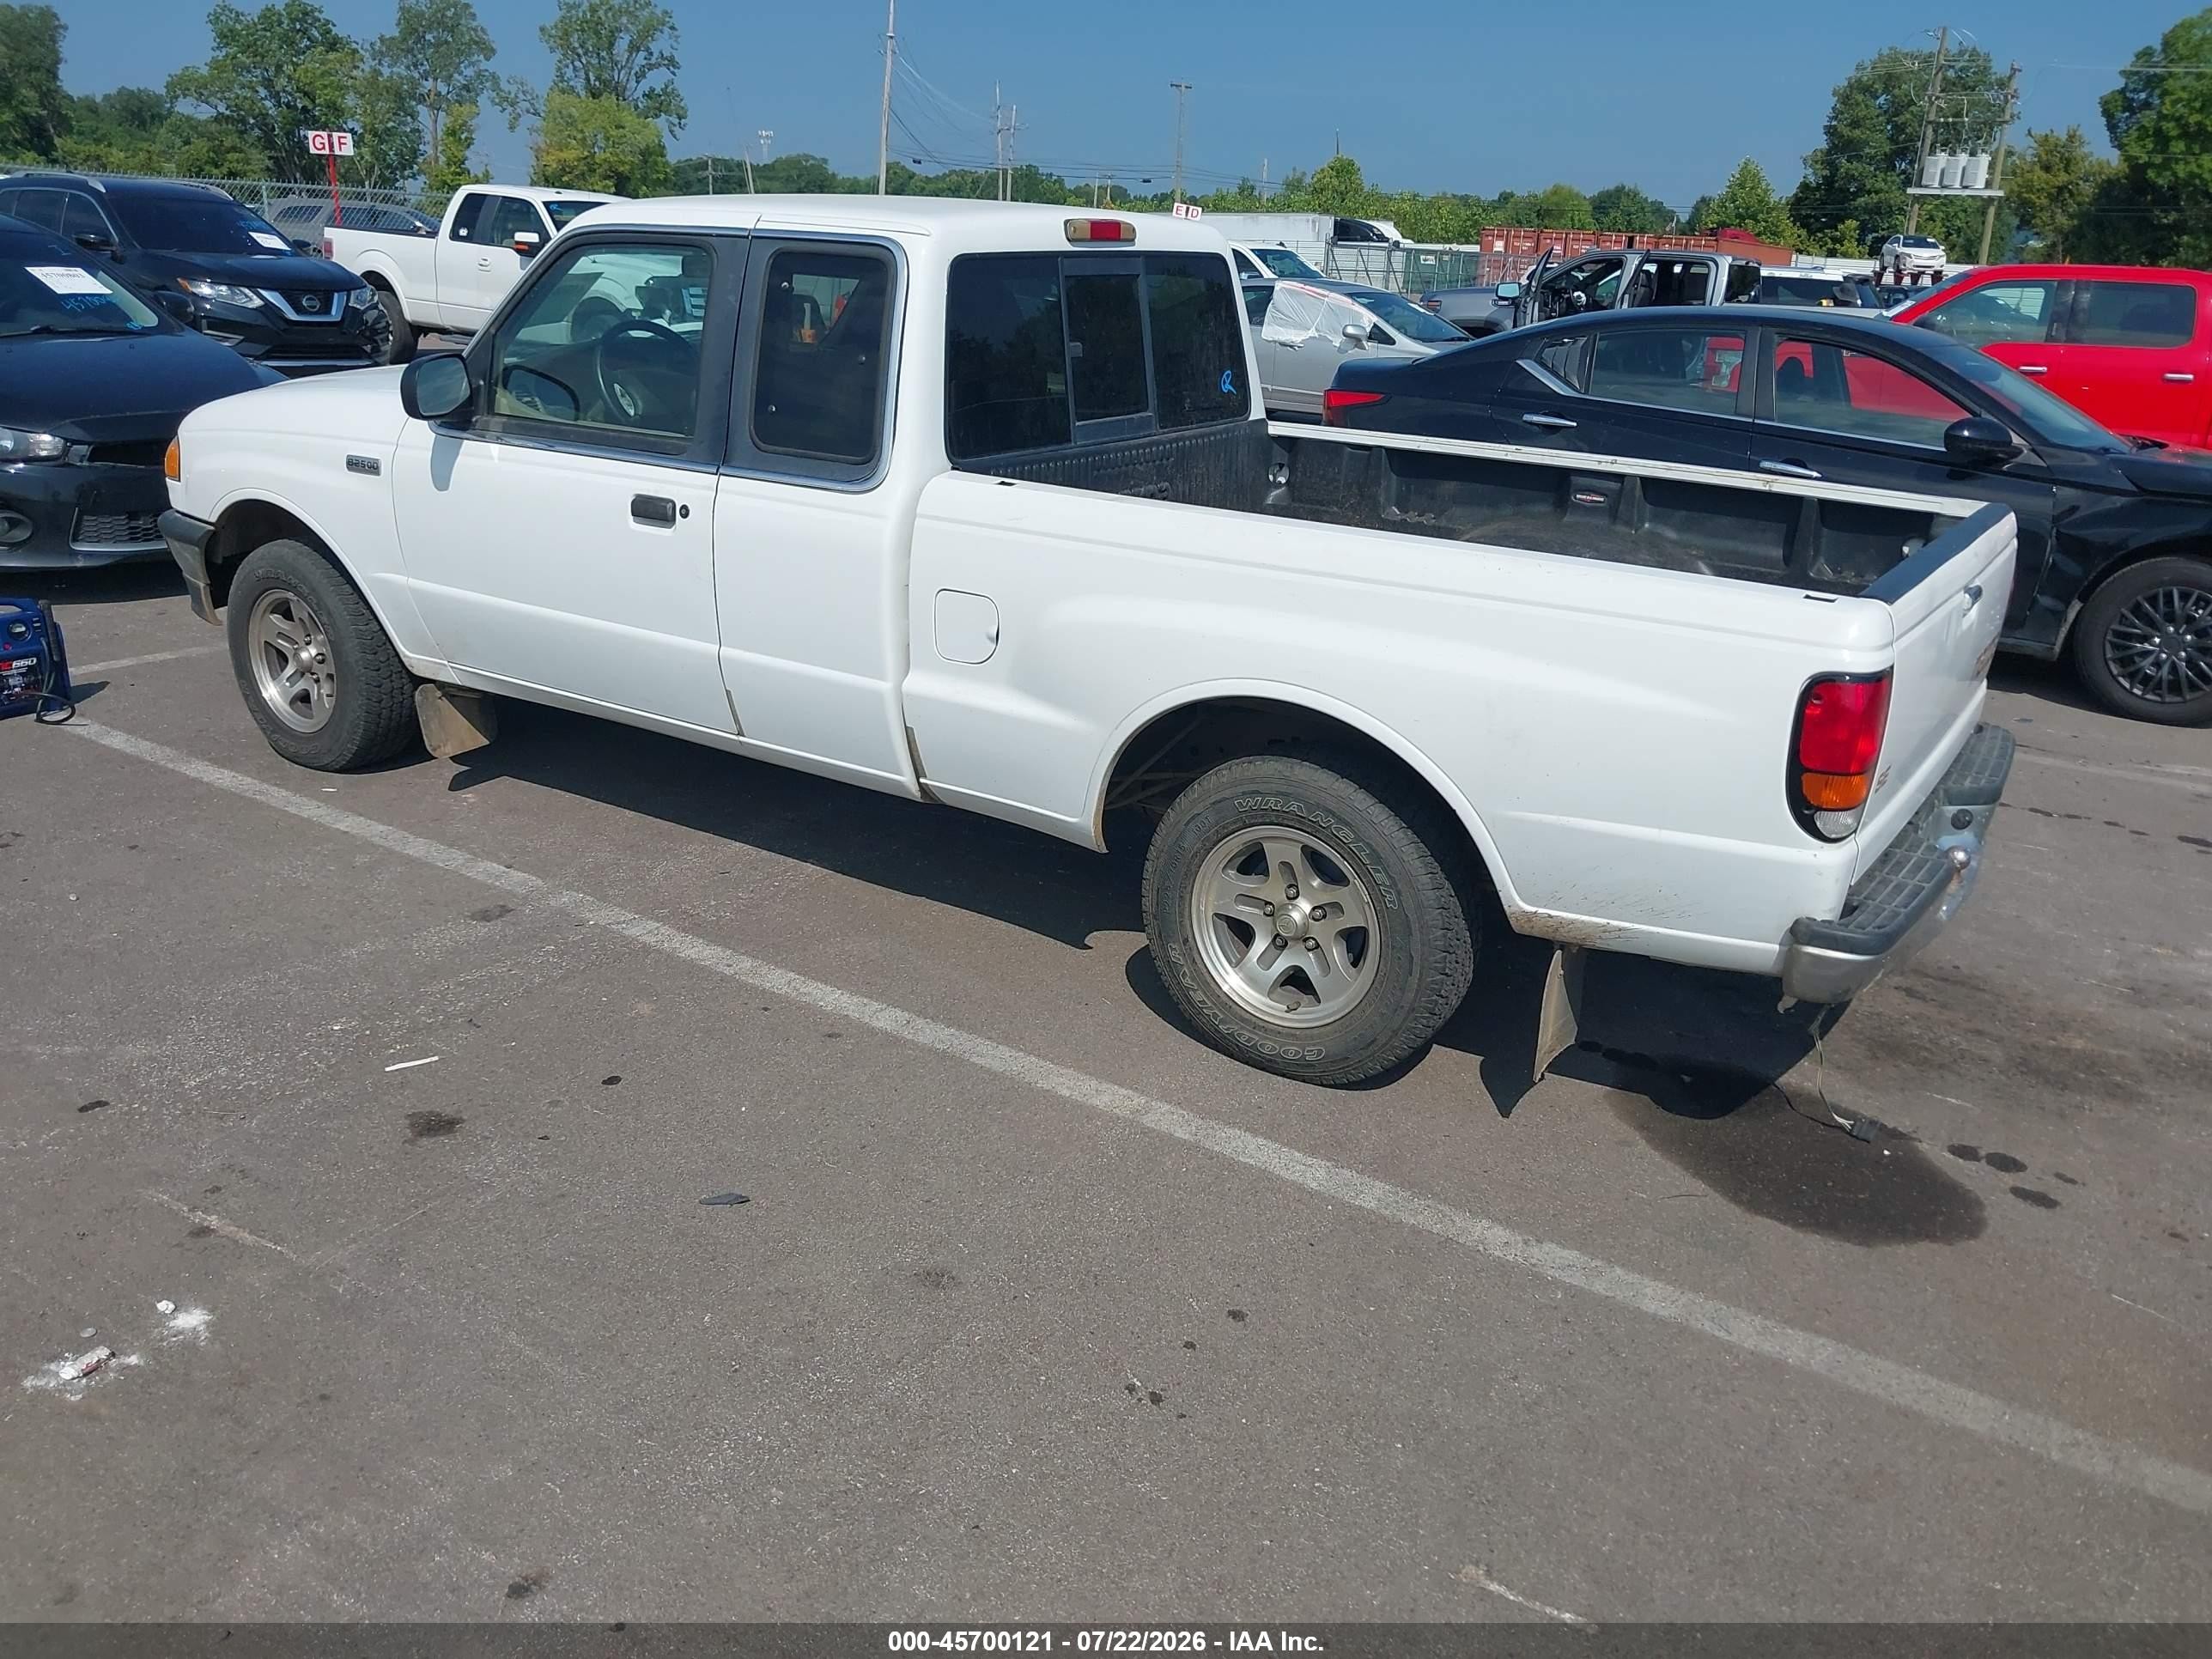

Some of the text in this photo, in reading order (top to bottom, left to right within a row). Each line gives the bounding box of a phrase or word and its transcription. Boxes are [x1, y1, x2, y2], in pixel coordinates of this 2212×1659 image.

[313, 133, 348, 152] G F
[1175, 205, 1200, 218] E D
[348, 458, 379, 470] B2500
[1234, 797, 1400, 910] WRANGLER
[1166, 942, 1326, 1062] GOODYEAR
